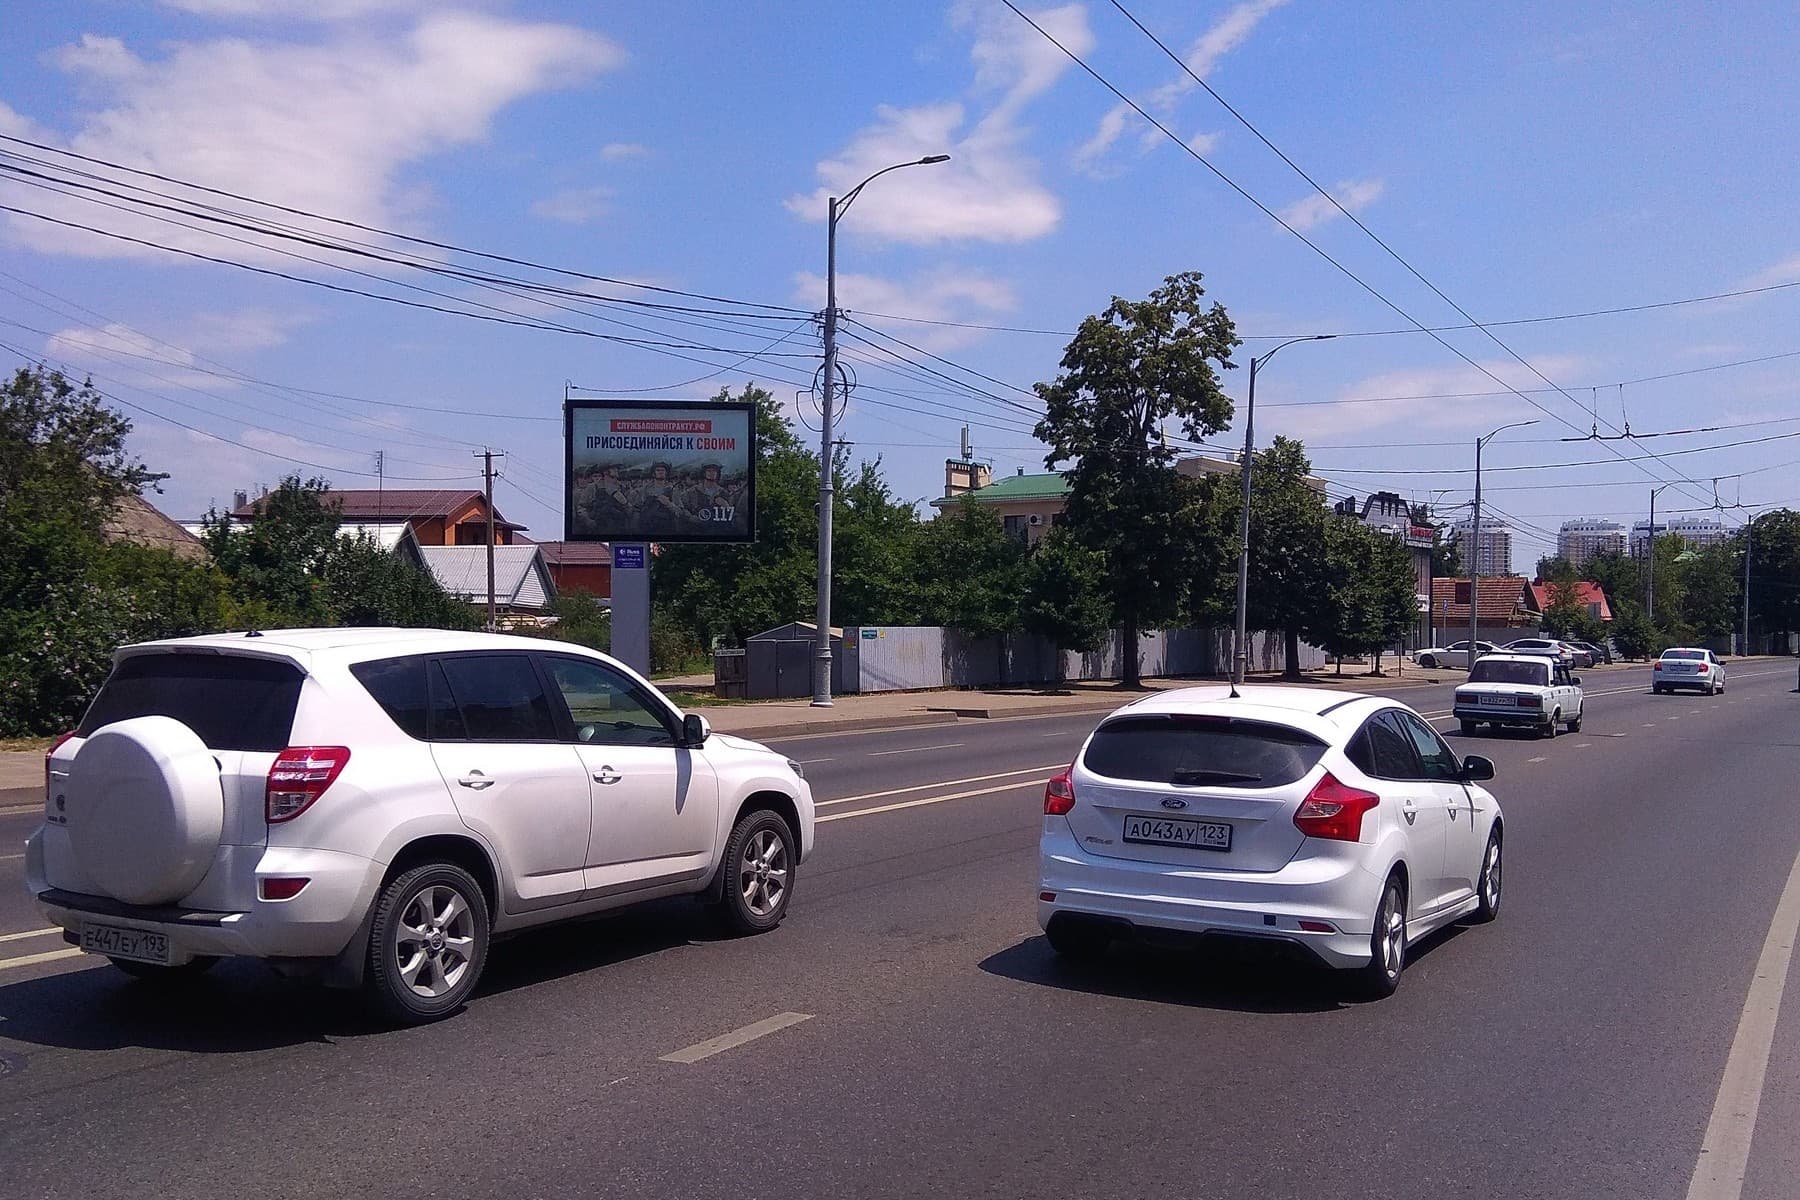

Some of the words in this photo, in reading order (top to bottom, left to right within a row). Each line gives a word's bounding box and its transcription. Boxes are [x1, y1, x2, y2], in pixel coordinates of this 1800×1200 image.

[586, 434, 683, 450] ПРИСОЕДИНЯЙСЯ
[686, 438, 694, 450] К
[696, 437, 736, 450] СВОИМ
[712, 506, 736, 522] 117
[1130, 821, 1196, 841] А043АУ
[1200, 825, 1226, 840] 123
[142, 933, 167, 953] 193
